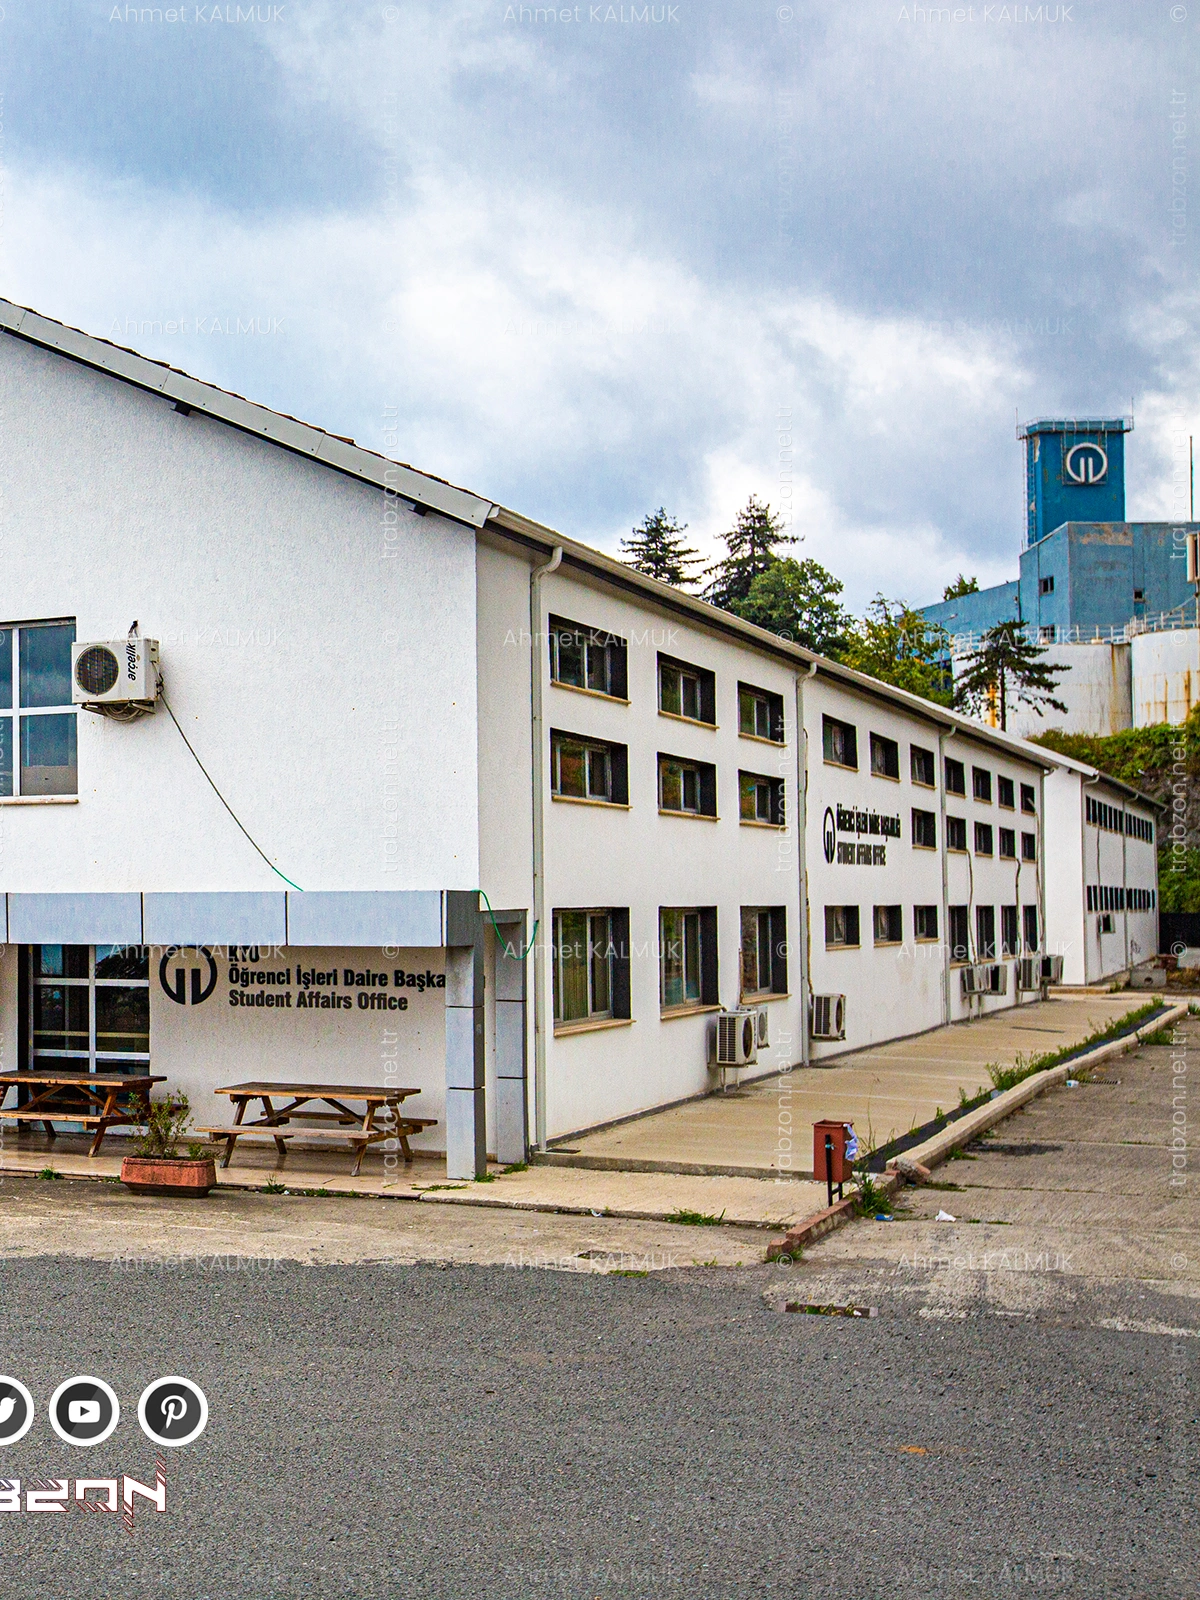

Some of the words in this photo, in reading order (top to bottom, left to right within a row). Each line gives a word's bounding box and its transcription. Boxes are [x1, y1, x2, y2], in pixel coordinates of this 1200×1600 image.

[125, 642, 138, 681] arçelik
[228, 963, 291, 988] Öğrenci
[296, 964, 338, 990] İşleri
[343, 968, 388, 987] Daire
[229, 989, 292, 1008] Student
[296, 990, 352, 1010] Affairs
[357, 991, 408, 1011] Office
